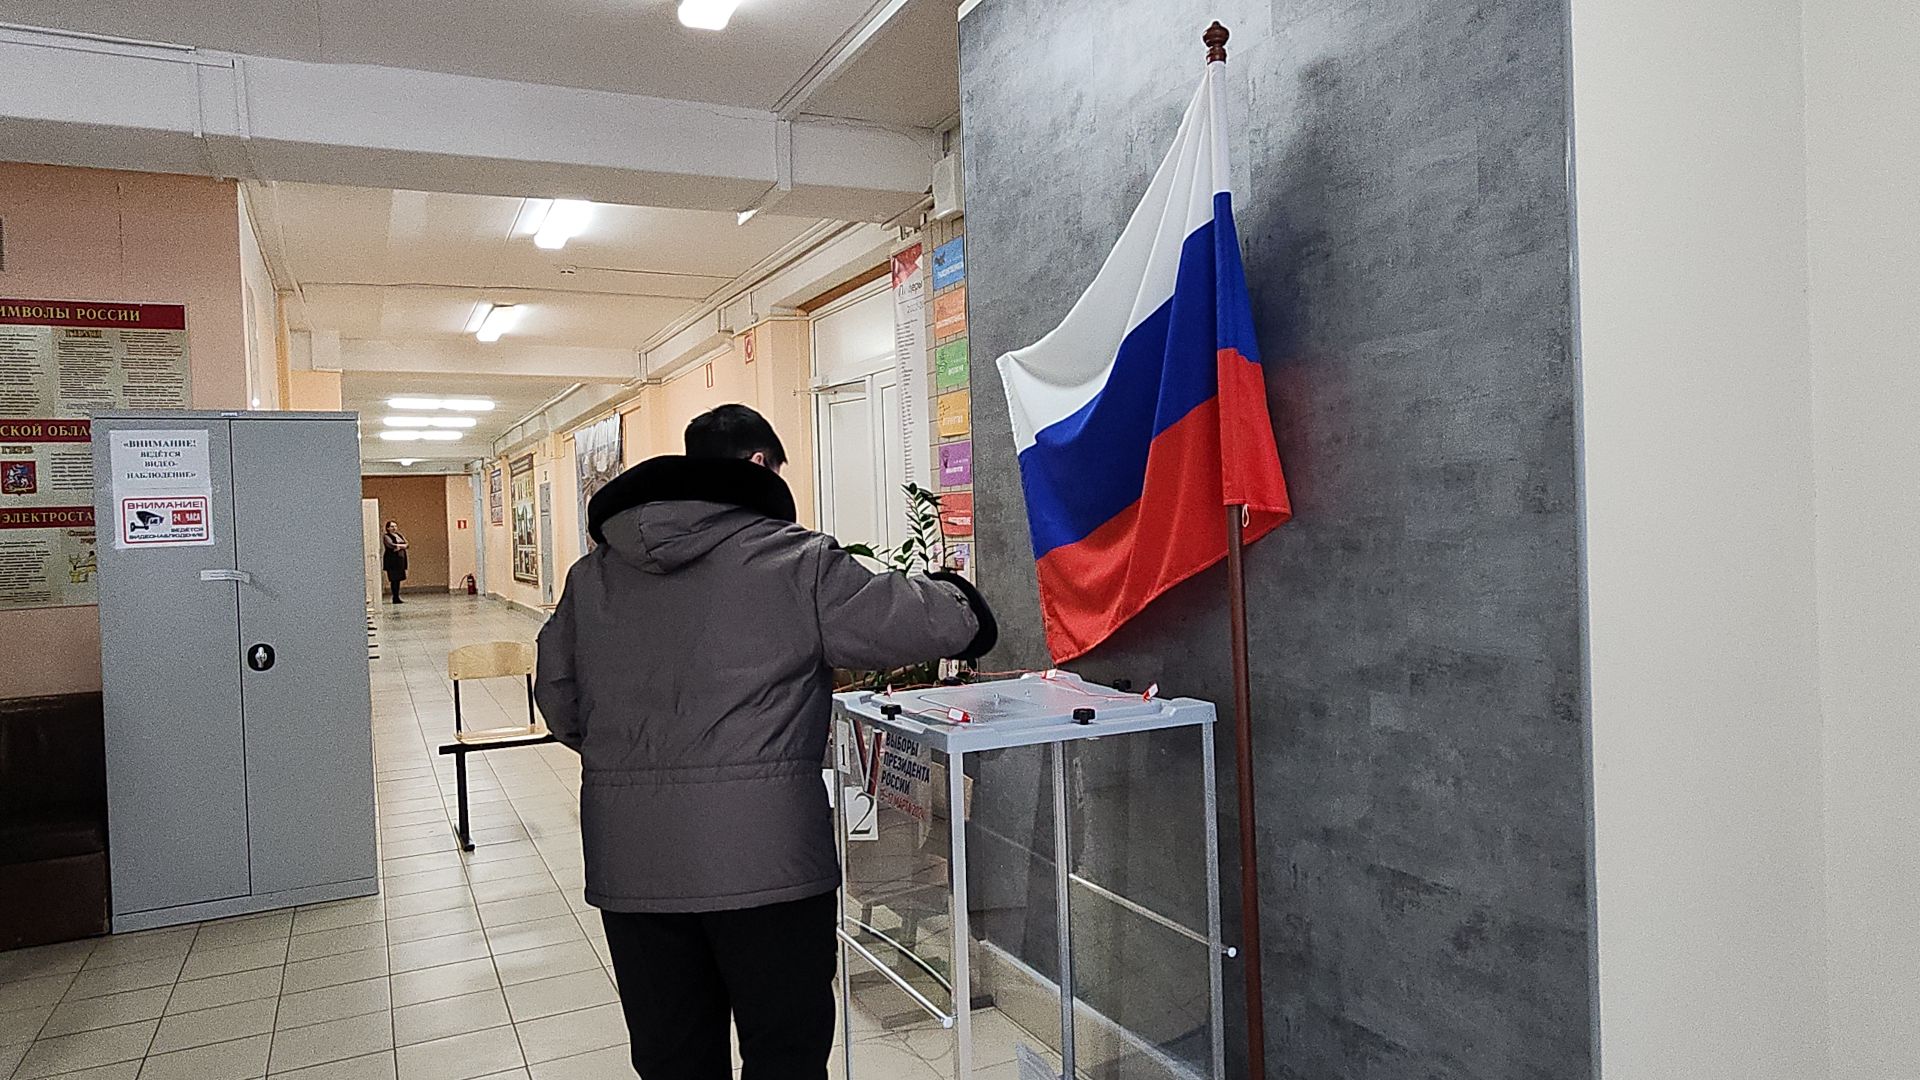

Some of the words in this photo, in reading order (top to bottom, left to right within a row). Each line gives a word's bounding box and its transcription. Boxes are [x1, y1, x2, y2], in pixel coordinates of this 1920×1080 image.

[77, 308, 140, 321] РОССИИ
[0, 423, 42, 436] СКОЙ
[48, 425, 91, 436] ОБЛА
[127, 500, 203, 510] ВНИМАНИЕ!
[2, 511, 93, 524] ЭЛЕКТРОСТА
[885, 732, 920, 757] ВЫБОРЫ
[883, 751, 931, 784] ПРЕЗИДЕНТА
[880, 770, 911, 795] РОССИИ
[850, 791, 875, 835] 2
